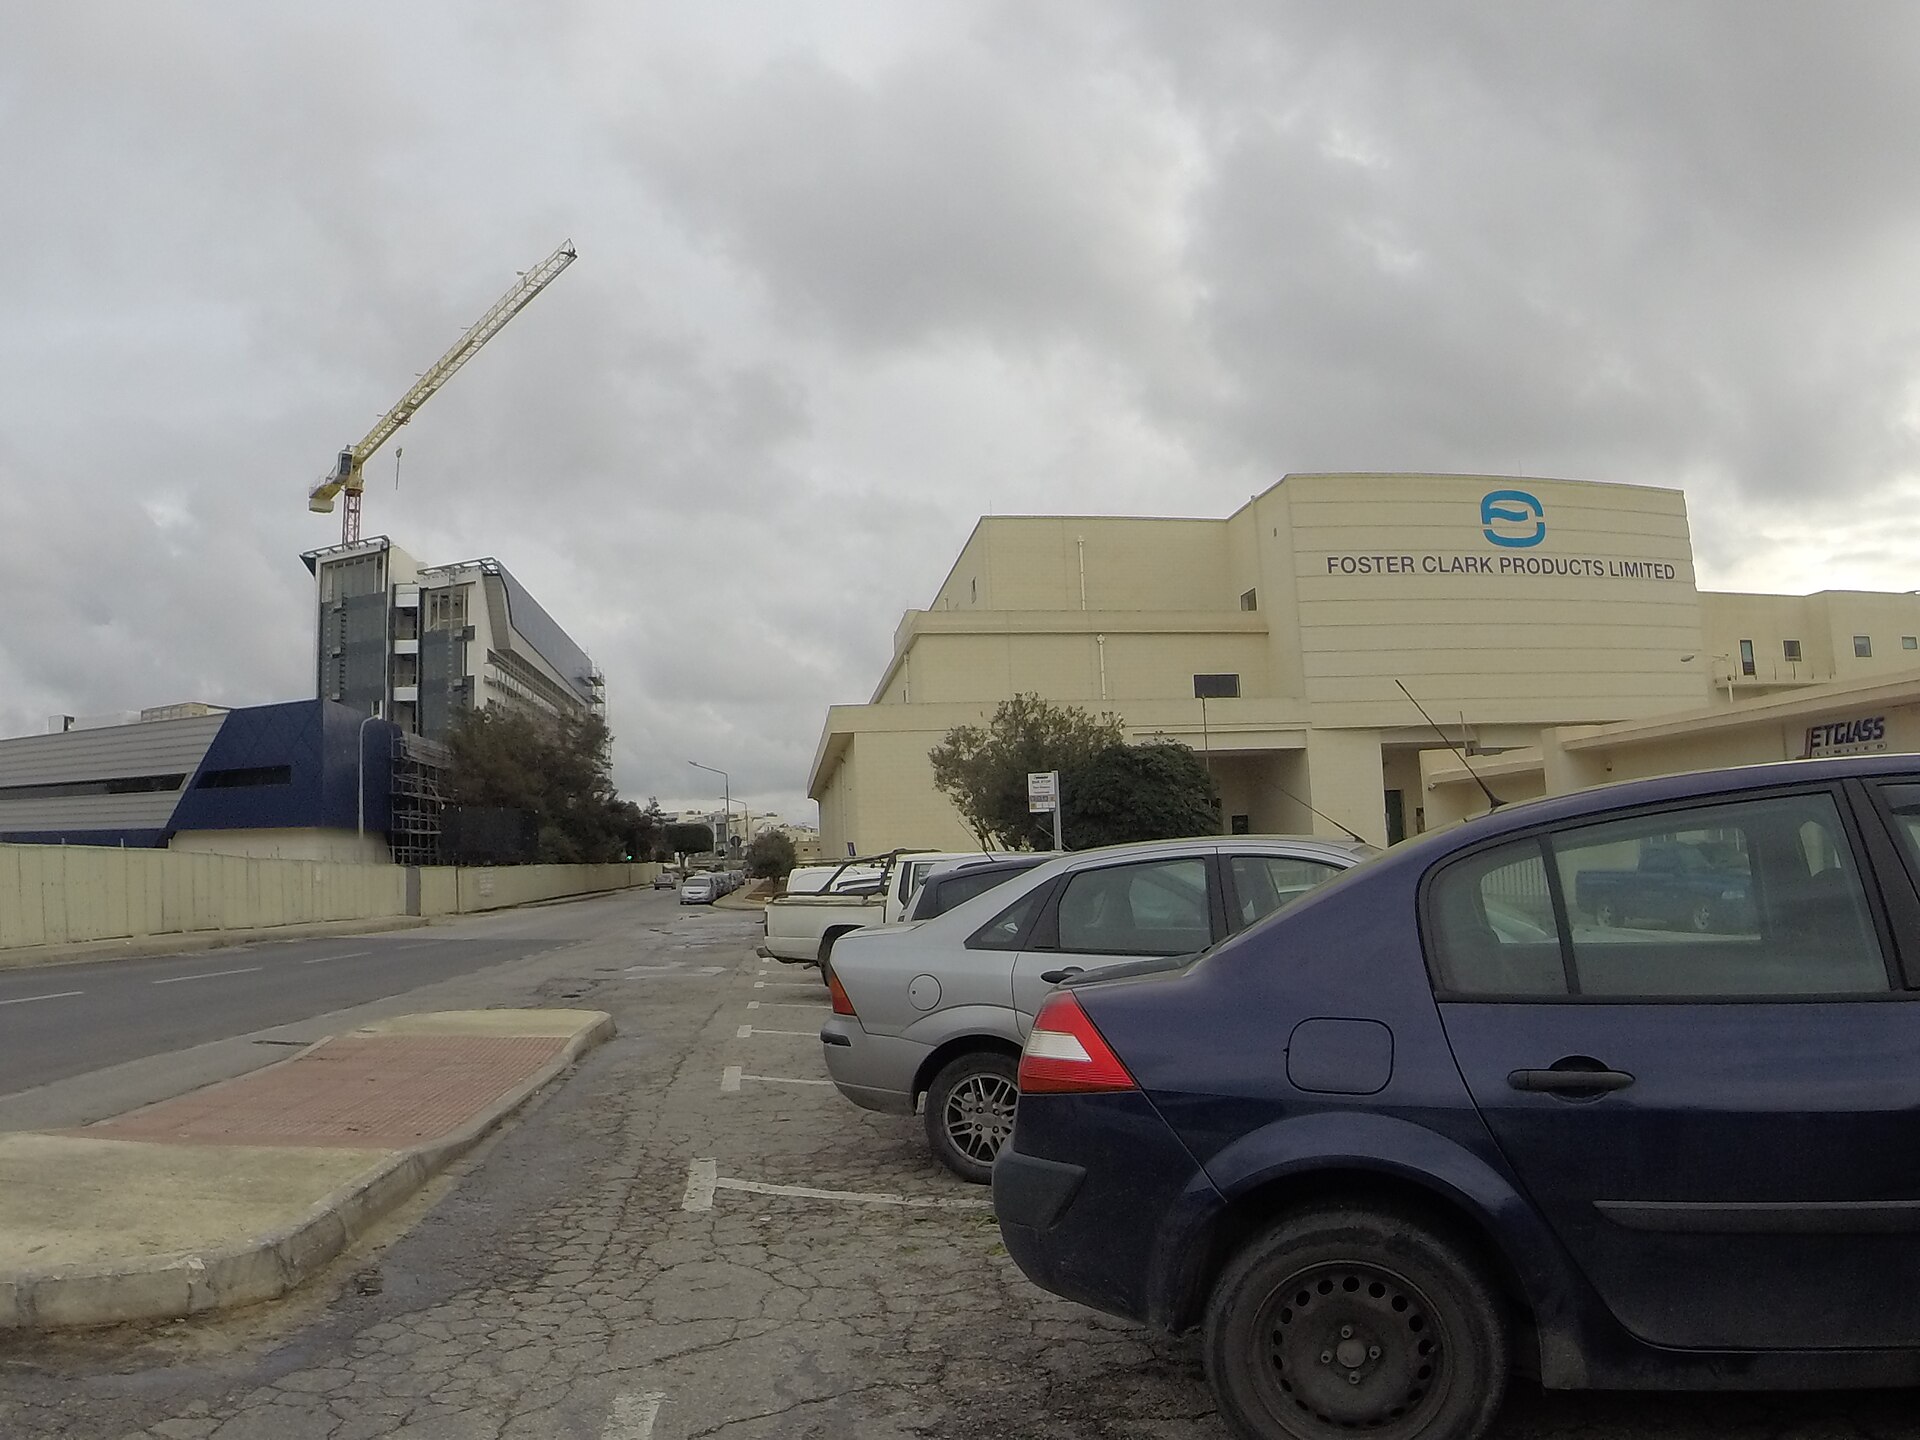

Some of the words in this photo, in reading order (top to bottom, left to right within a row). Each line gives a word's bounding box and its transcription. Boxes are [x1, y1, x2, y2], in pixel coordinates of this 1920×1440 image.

[1326, 556, 1415, 574] FOSTER
[1421, 555, 1494, 574] CLARK
[1499, 556, 1605, 576] PRODUCTS
[1608, 560, 1676, 580] LIMITED
